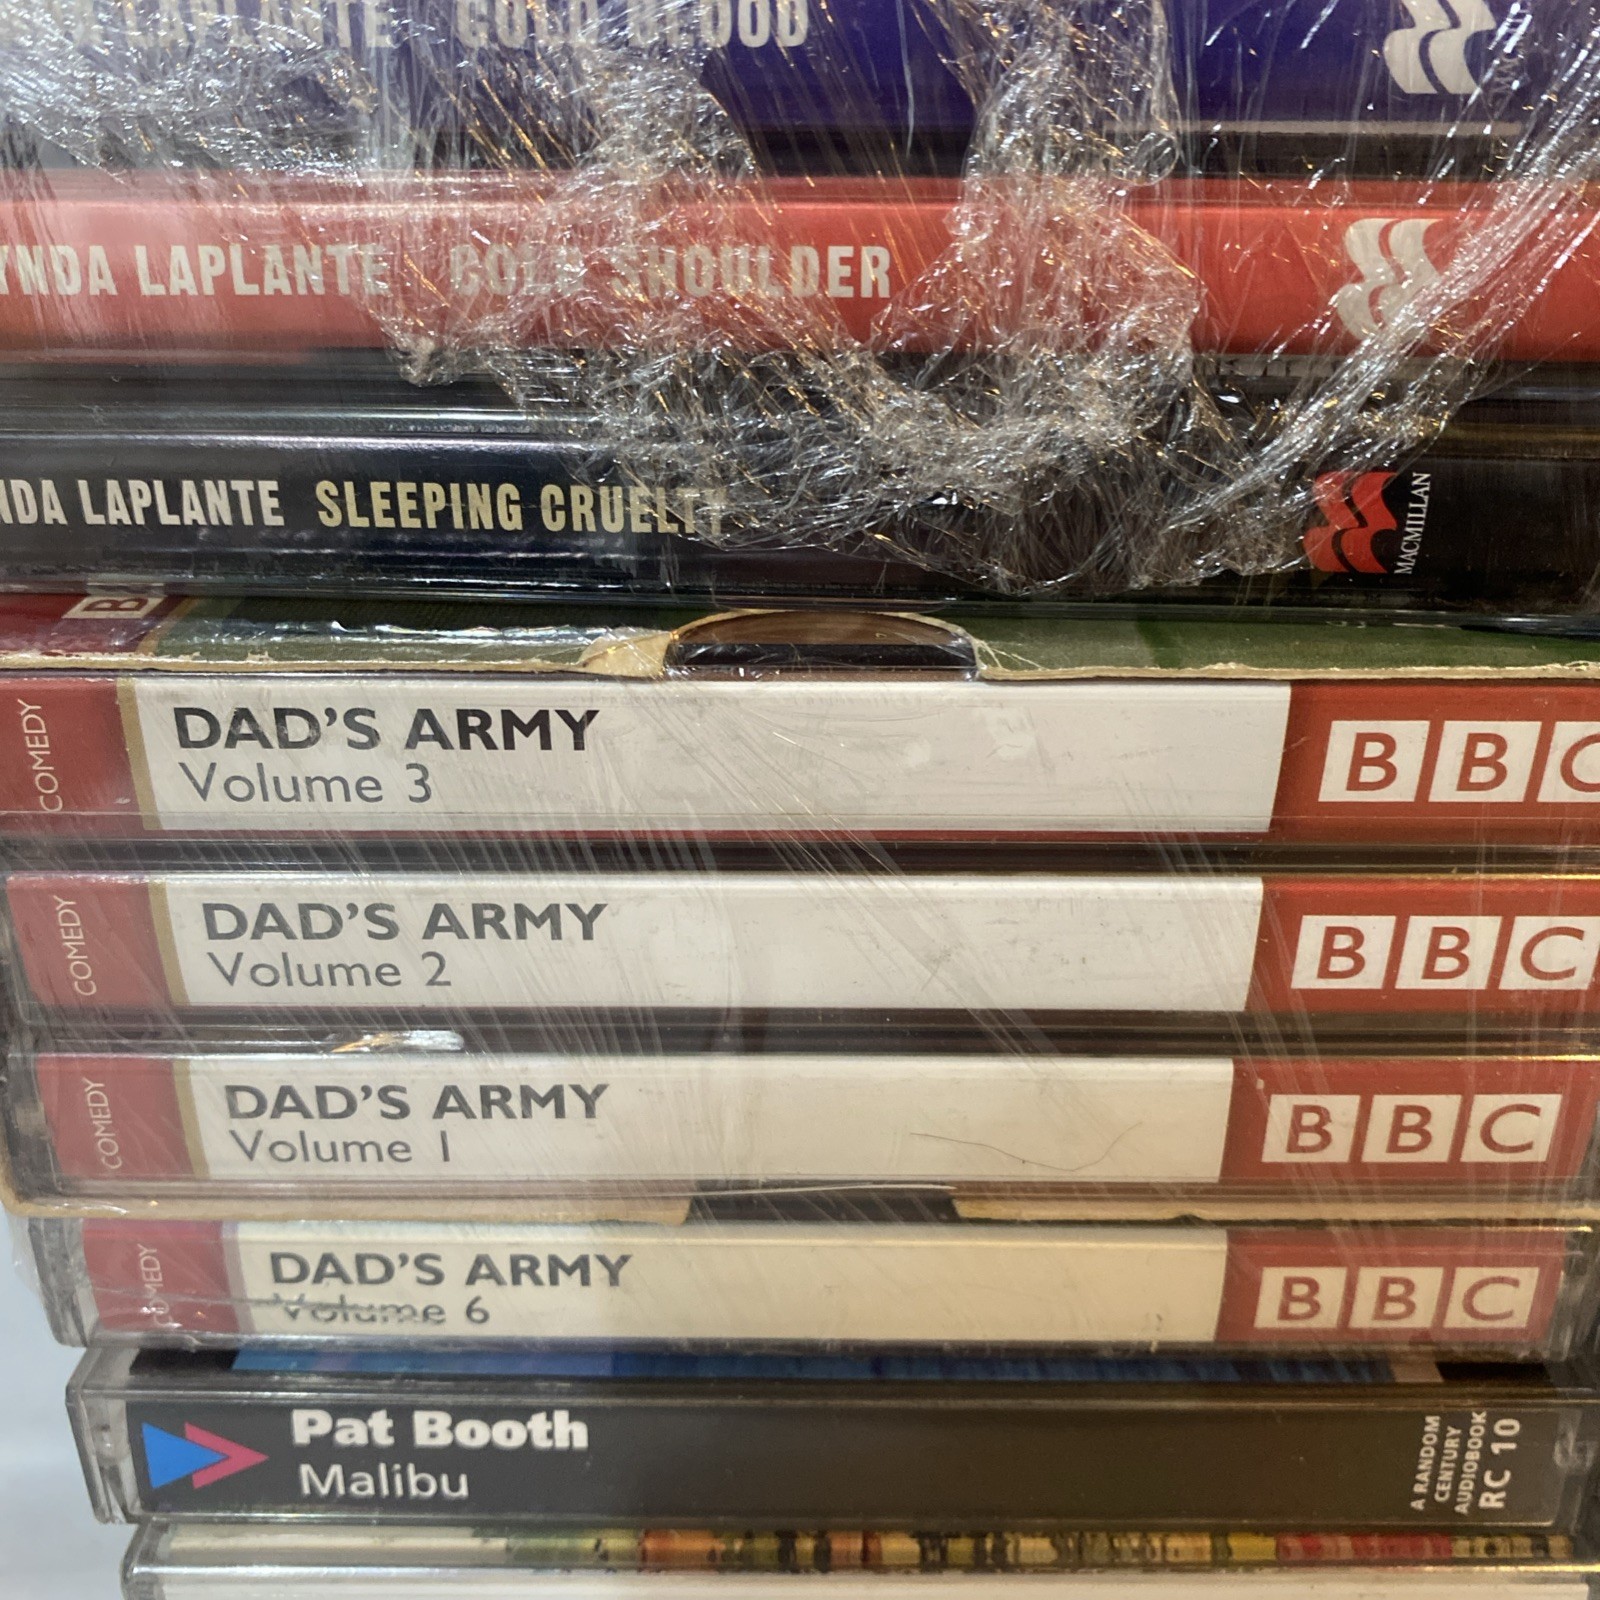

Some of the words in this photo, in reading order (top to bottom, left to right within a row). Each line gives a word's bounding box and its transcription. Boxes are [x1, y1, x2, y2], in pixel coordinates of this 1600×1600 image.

[134, 244, 389, 296] LAPLANTE
[78, 479, 285, 526] LAPLANTE
[315, 480, 523, 531] SLEEPING
[540, 484, 727, 536] CRUELTY
[1394, 472, 1431, 575] MACMILLAN
[172, 707, 381, 751] DAD'S
[405, 709, 600, 751] ARMY
[19, 697, 64, 813] COMEDY
[1345, 732, 1600, 793] BBC
[179, 761, 383, 804] Volume
[407, 763, 433, 804] 3
[202, 902, 399, 942] DAD'S
[421, 903, 608, 942] ARMY
[56, 895, 97, 997] COMEDY
[1316, 926, 1585, 982] BBC
[207, 952, 401, 988] Volume
[422, 952, 453, 988] 2
[84, 1078, 122, 1170] COMEDY
[224, 1083, 410, 1121] DAD'S
[432, 1084, 610, 1120] ARMY
[230, 1130, 412, 1164] Volume
[1285, 1103, 1542, 1154] BBC
[270, 1252, 446, 1287] DAD'S
[465, 1254, 634, 1288] ARMY
[273, 1293, 447, 1324] Volume
[465, 1295, 490, 1325] 6
[1276, 1275, 1521, 1322] BBC
[291, 1408, 395, 1446] Pat
[413, 1409, 589, 1449] Booth
[1490, 1418, 1521, 1455] 10
[1413, 1415, 1441, 1494] RANDOM
[1434, 1426, 1462, 1502] CENTURY
[1454, 1411, 1487, 1515] AUDIOBOOK
[299, 1462, 469, 1499] Malibu
[1478, 1469, 1511, 1509] RC
[1410, 1499, 1426, 1511] A
